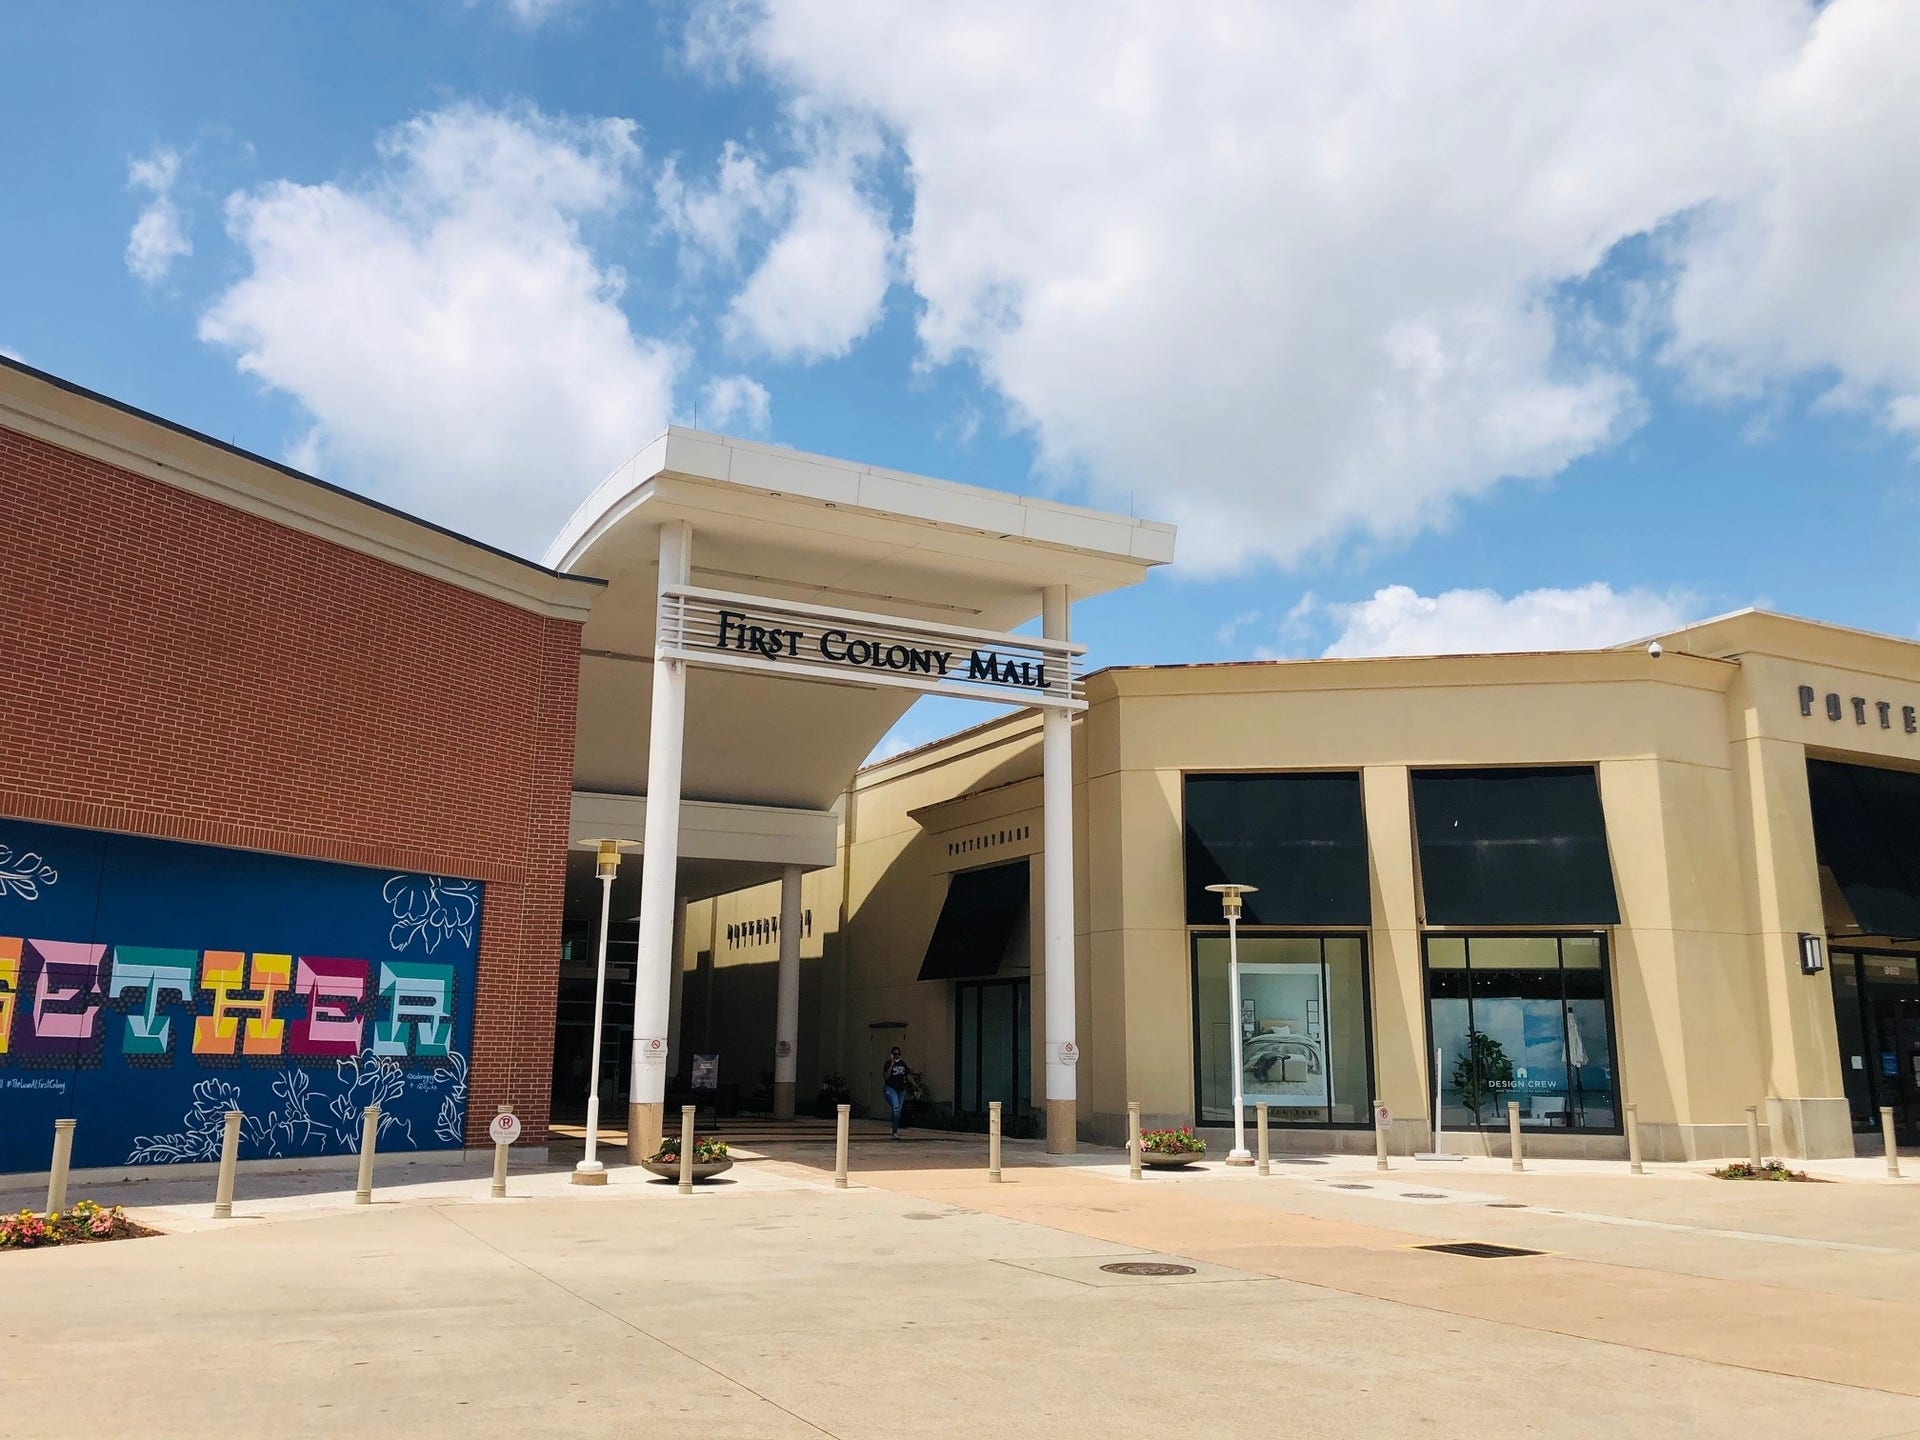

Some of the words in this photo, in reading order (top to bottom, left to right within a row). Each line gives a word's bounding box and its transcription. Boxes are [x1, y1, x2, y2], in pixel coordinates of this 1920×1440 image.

[717, 610, 804, 660] FIRST
[820, 630, 952, 675] COLONY
[967, 649, 1051, 687] MALL
[1488, 1080, 1525, 1088] DESIGN
[1527, 1080, 1557, 1088] CREW
